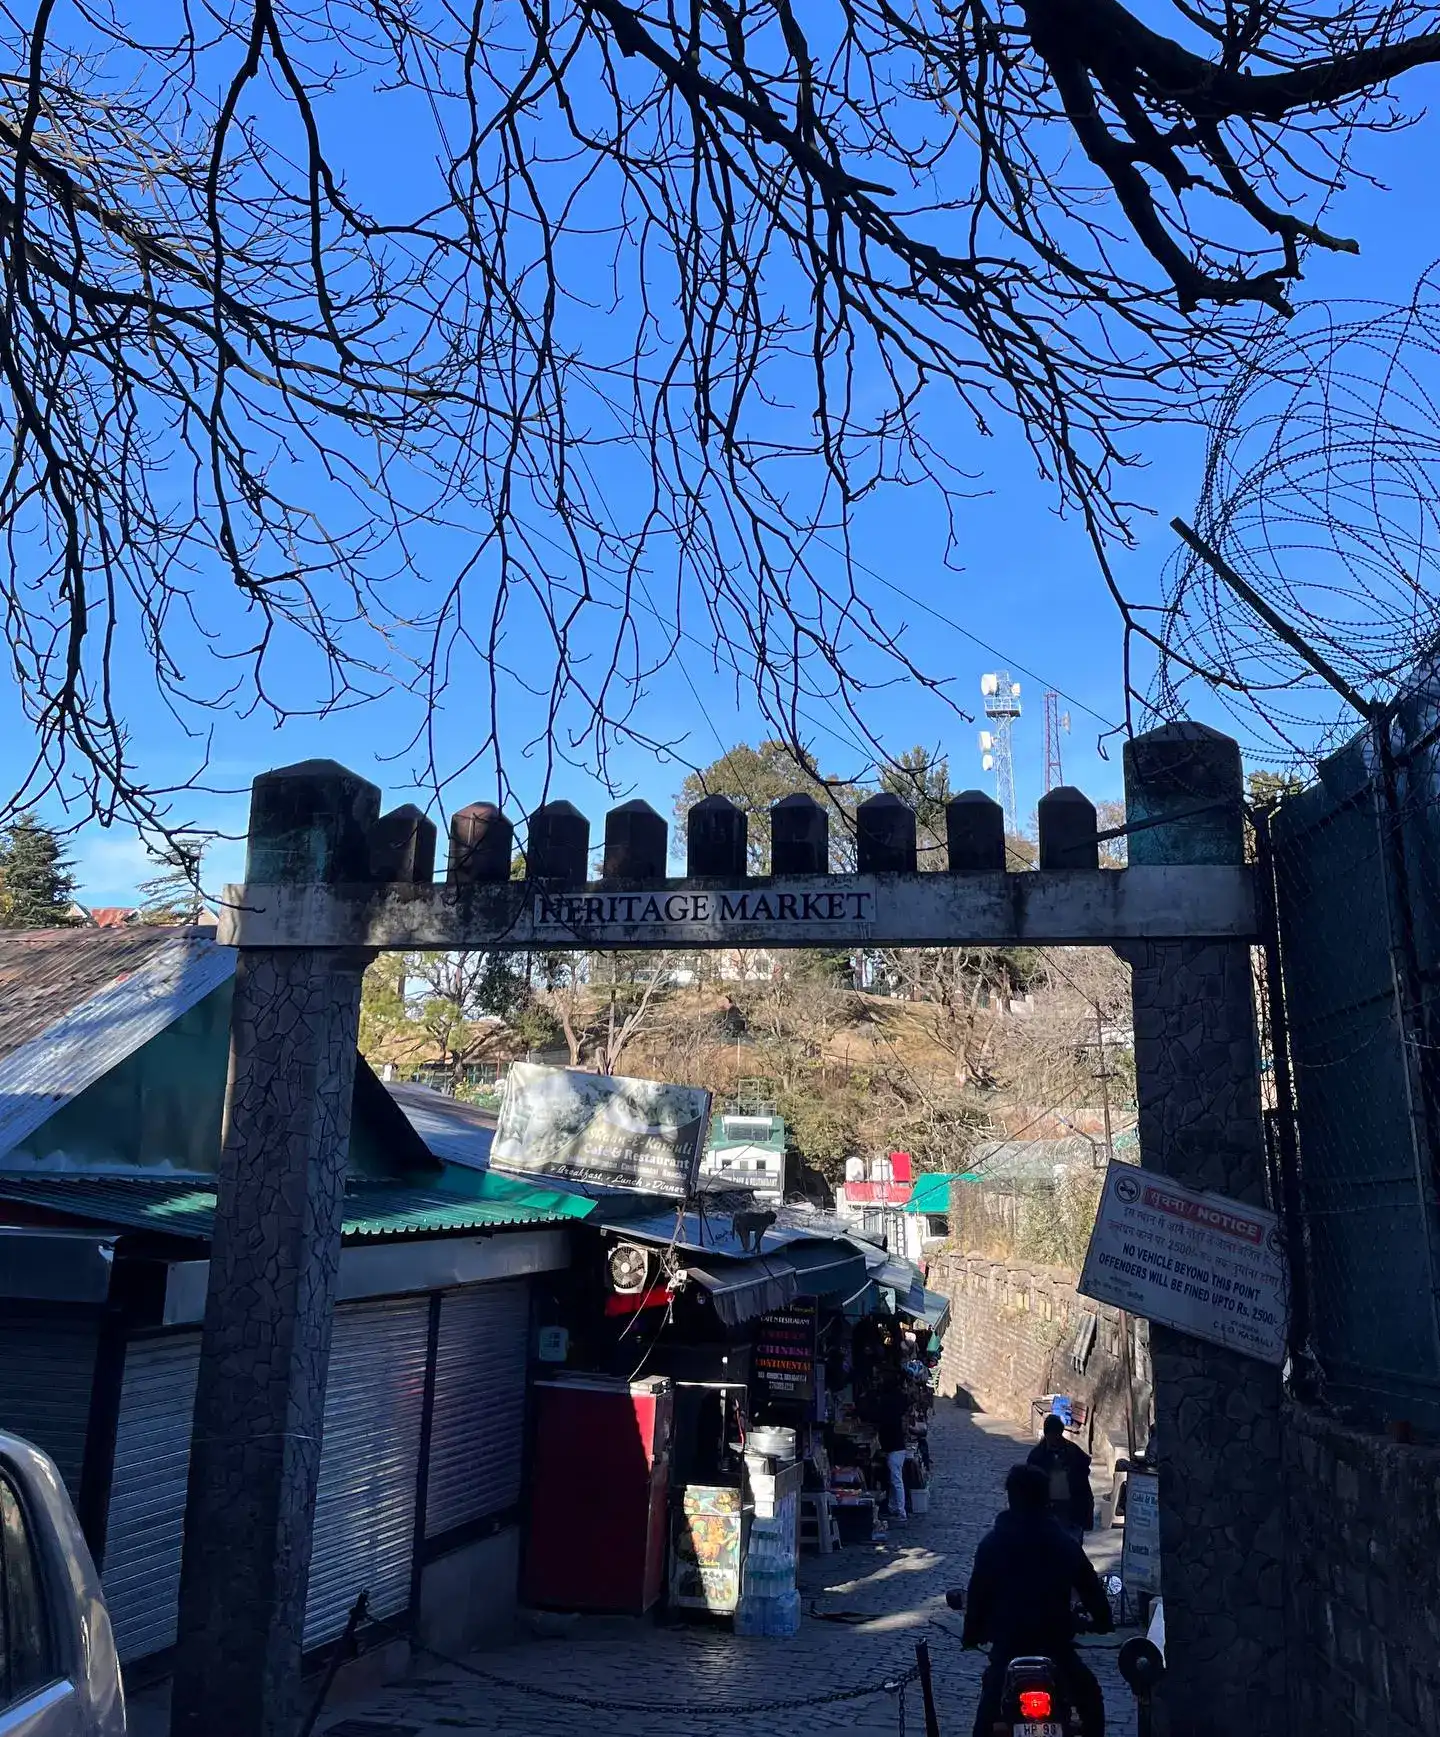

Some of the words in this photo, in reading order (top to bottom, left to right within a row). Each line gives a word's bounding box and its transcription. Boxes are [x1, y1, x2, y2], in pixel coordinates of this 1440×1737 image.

[540, 895, 709, 923] HERITAGE
[719, 892, 871, 921] MARKET
[611, 1147, 620, 1158] &
[624, 1149, 690, 1170] Restaurant
[612, 1174, 643, 1187] Lunch
[652, 1180, 685, 1194] Dinner
[1197, 1206, 1258, 1237] NOTICE
[1099, 1253, 1147, 1280] OFFENDERS
[1149, 1270, 1168, 1287] WILL
[1170, 1279, 1183, 1292] BE
[1184, 1284, 1210, 1302] FINED
[1212, 1293, 1235, 1311] UPTO
[1237, 1302, 1250, 1317] Rs.
[1123, 1243, 1135, 1256] NO
[1137, 1249, 1173, 1271] VEHICLE
[1175, 1260, 1209, 1283] BEYOND
[1212, 1274, 1231, 1291] THIS
[1233, 1282, 1261, 1301] POINT
